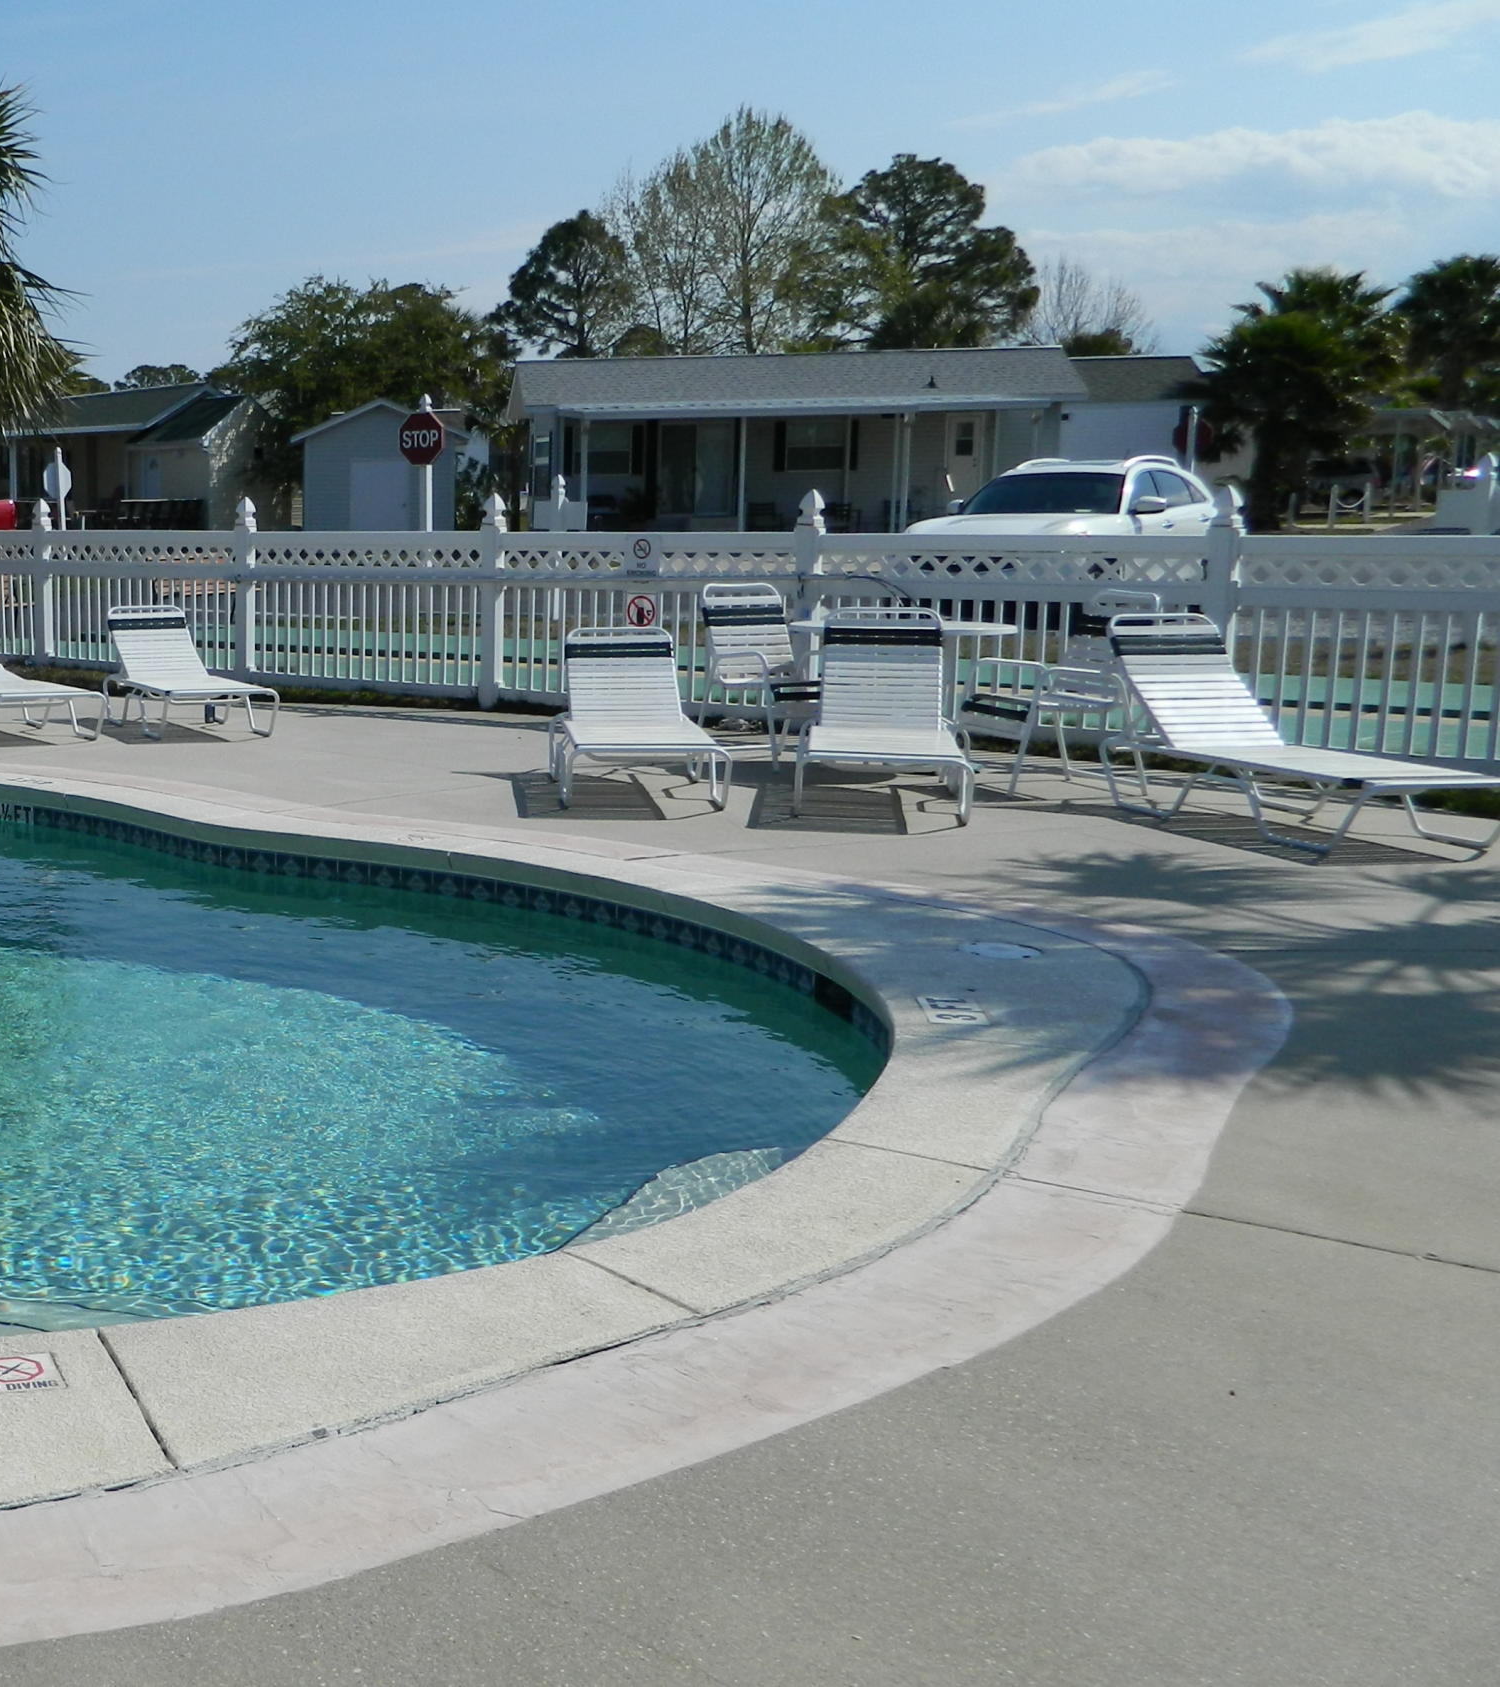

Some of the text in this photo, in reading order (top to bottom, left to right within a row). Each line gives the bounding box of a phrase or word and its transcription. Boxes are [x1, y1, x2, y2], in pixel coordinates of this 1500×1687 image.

[402, 430, 439, 449] STOP
[935, 1013, 978, 1021] 3
[6, 1379, 60, 1391] DIVING
